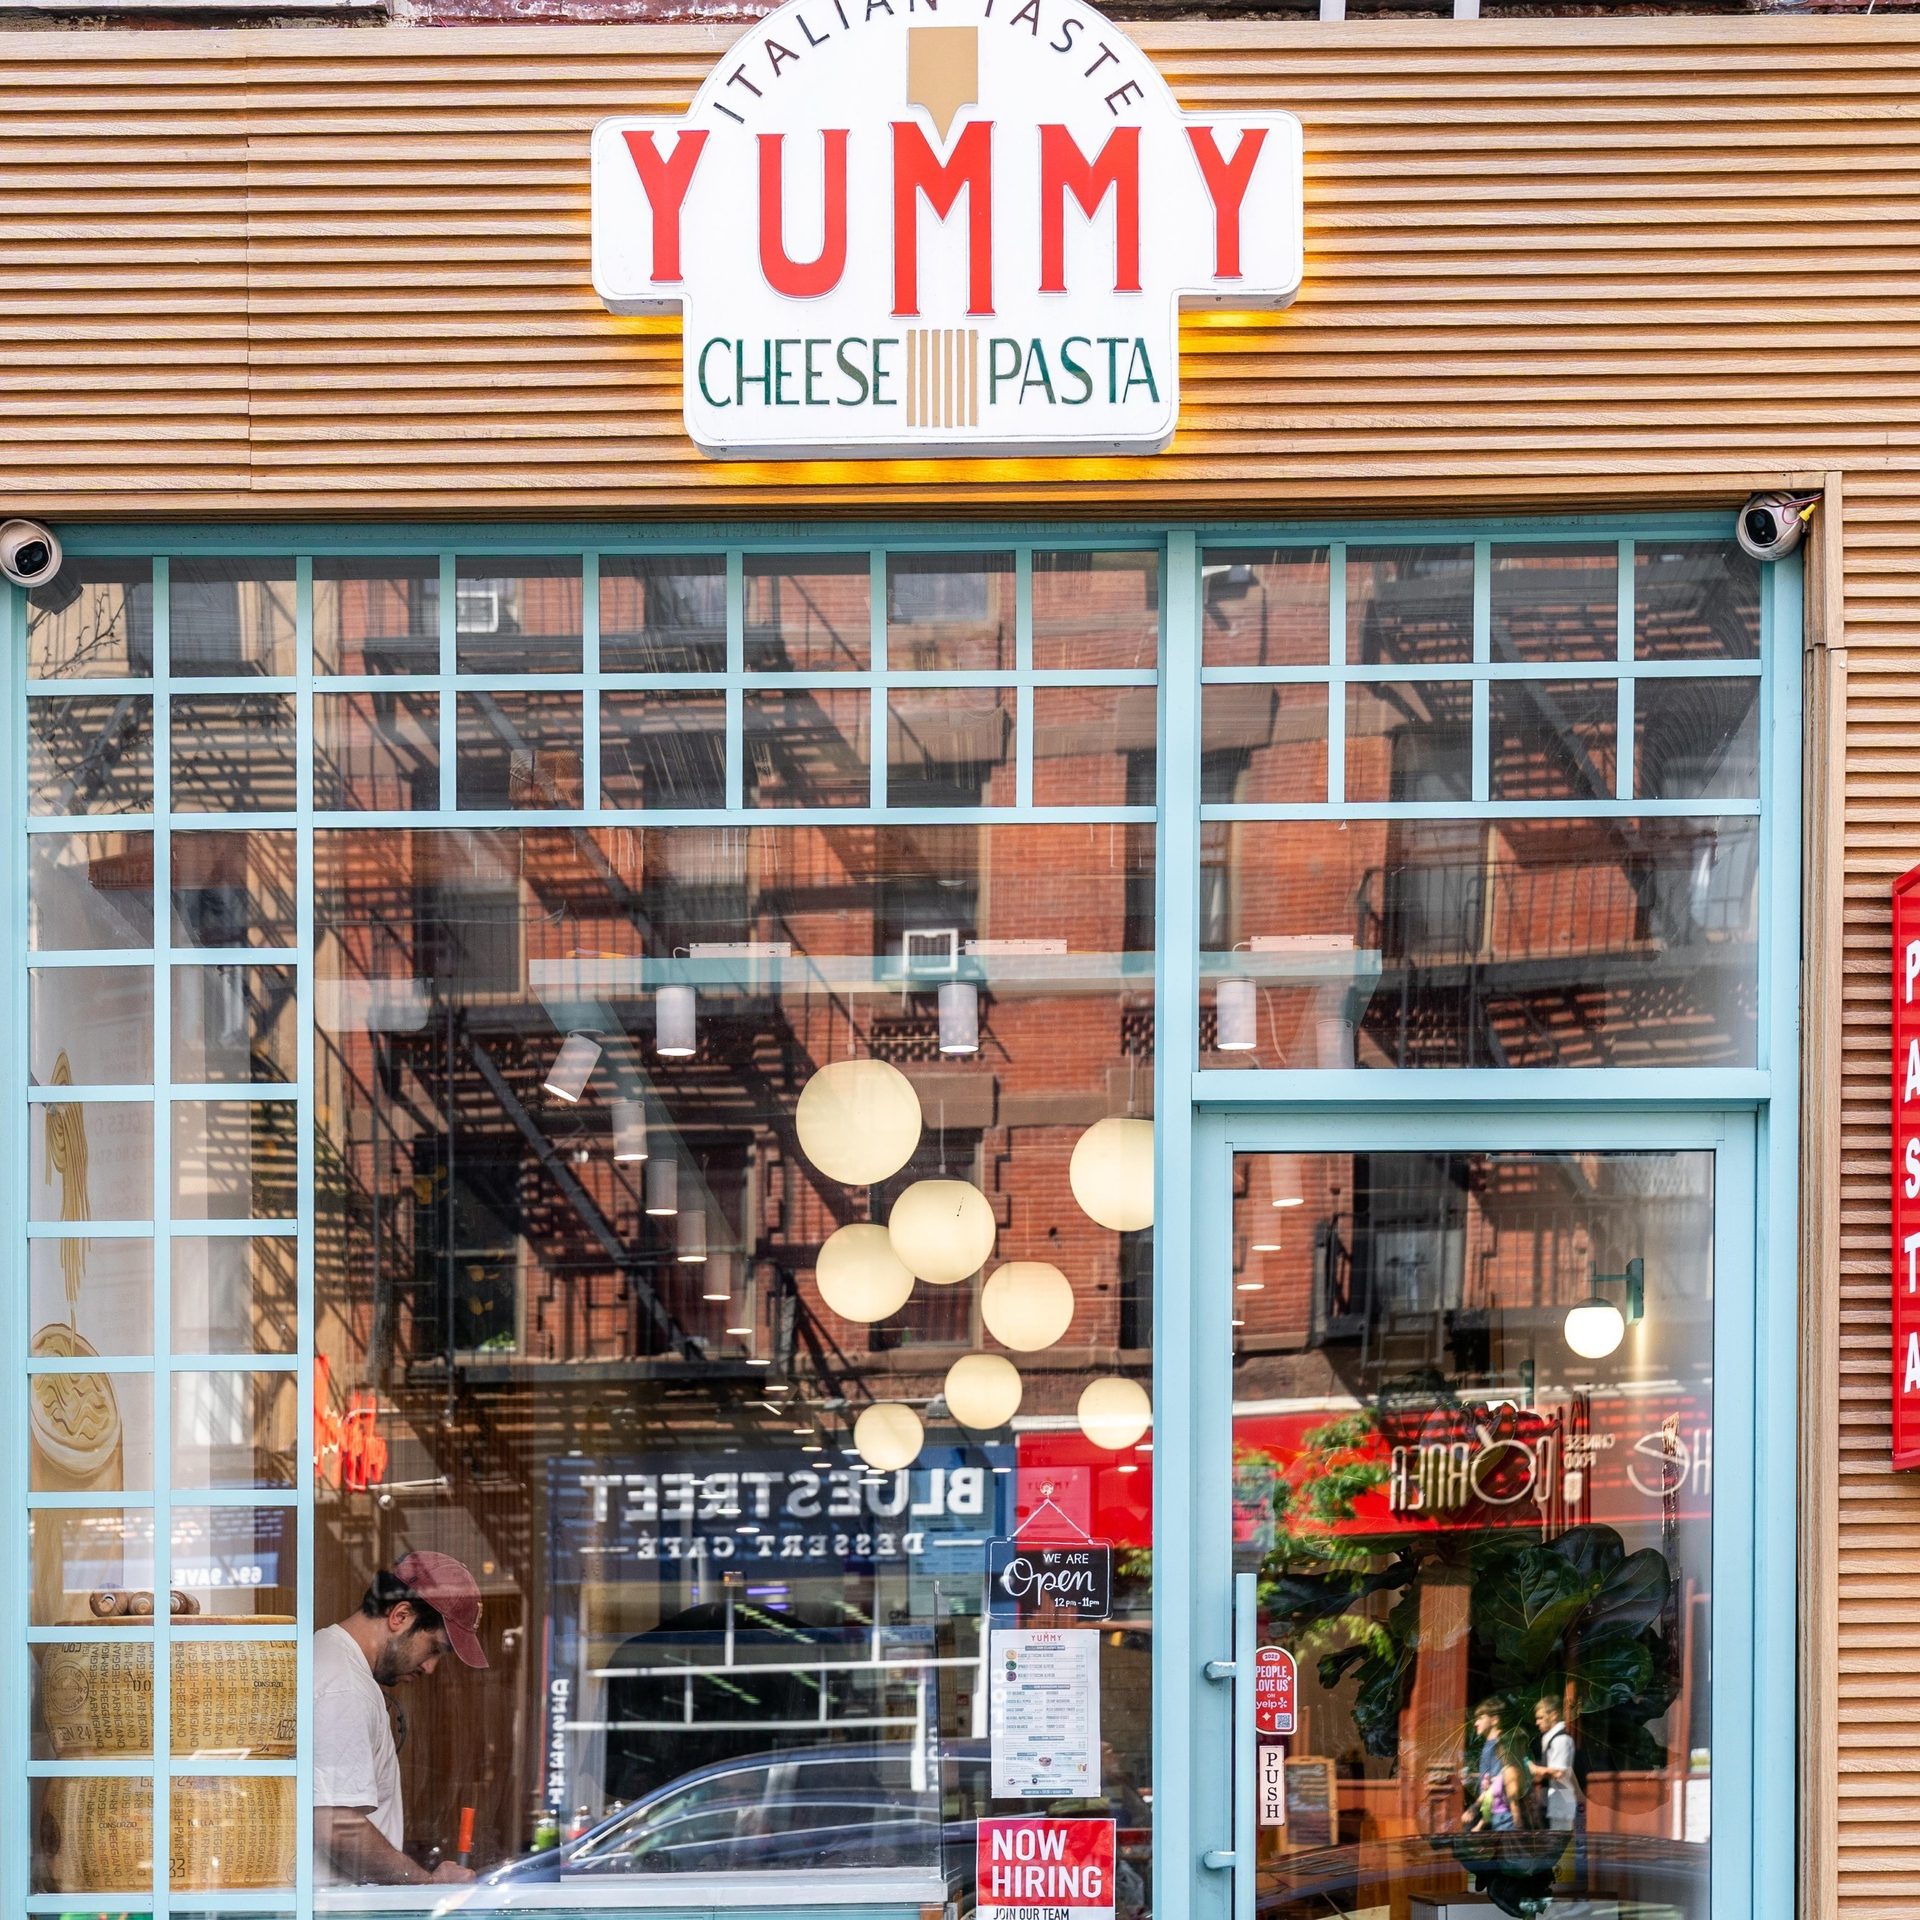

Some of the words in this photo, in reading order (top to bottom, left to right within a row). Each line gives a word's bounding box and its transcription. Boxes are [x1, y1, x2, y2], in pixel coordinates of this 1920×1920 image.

[622, 120, 1270, 319] YUMMY
[698, 337, 899, 407] CHEESE
[989, 336, 1160, 406] PASTA
[1043, 1553, 1062, 1564] WE
[1066, 1553, 1089, 1564] ARE
[1002, 1557, 1096, 1606] Open
[1031, 1634, 1063, 1642] YUMMY
[1256, 1665, 1287, 1678] PEOPLE
[1277, 1680, 1289, 1691] US
[1256, 1699, 1277, 1709] yelp
[1265, 1752, 1280, 1819] PUSH
[992, 1828, 1067, 1861] NOW
[992, 1865, 1102, 1898] HIRING
[993, 1908, 1016, 1920] JOIN
[1019, 1908, 1039, 1920] OUR
[1042, 1908, 1070, 1920] TEAM
